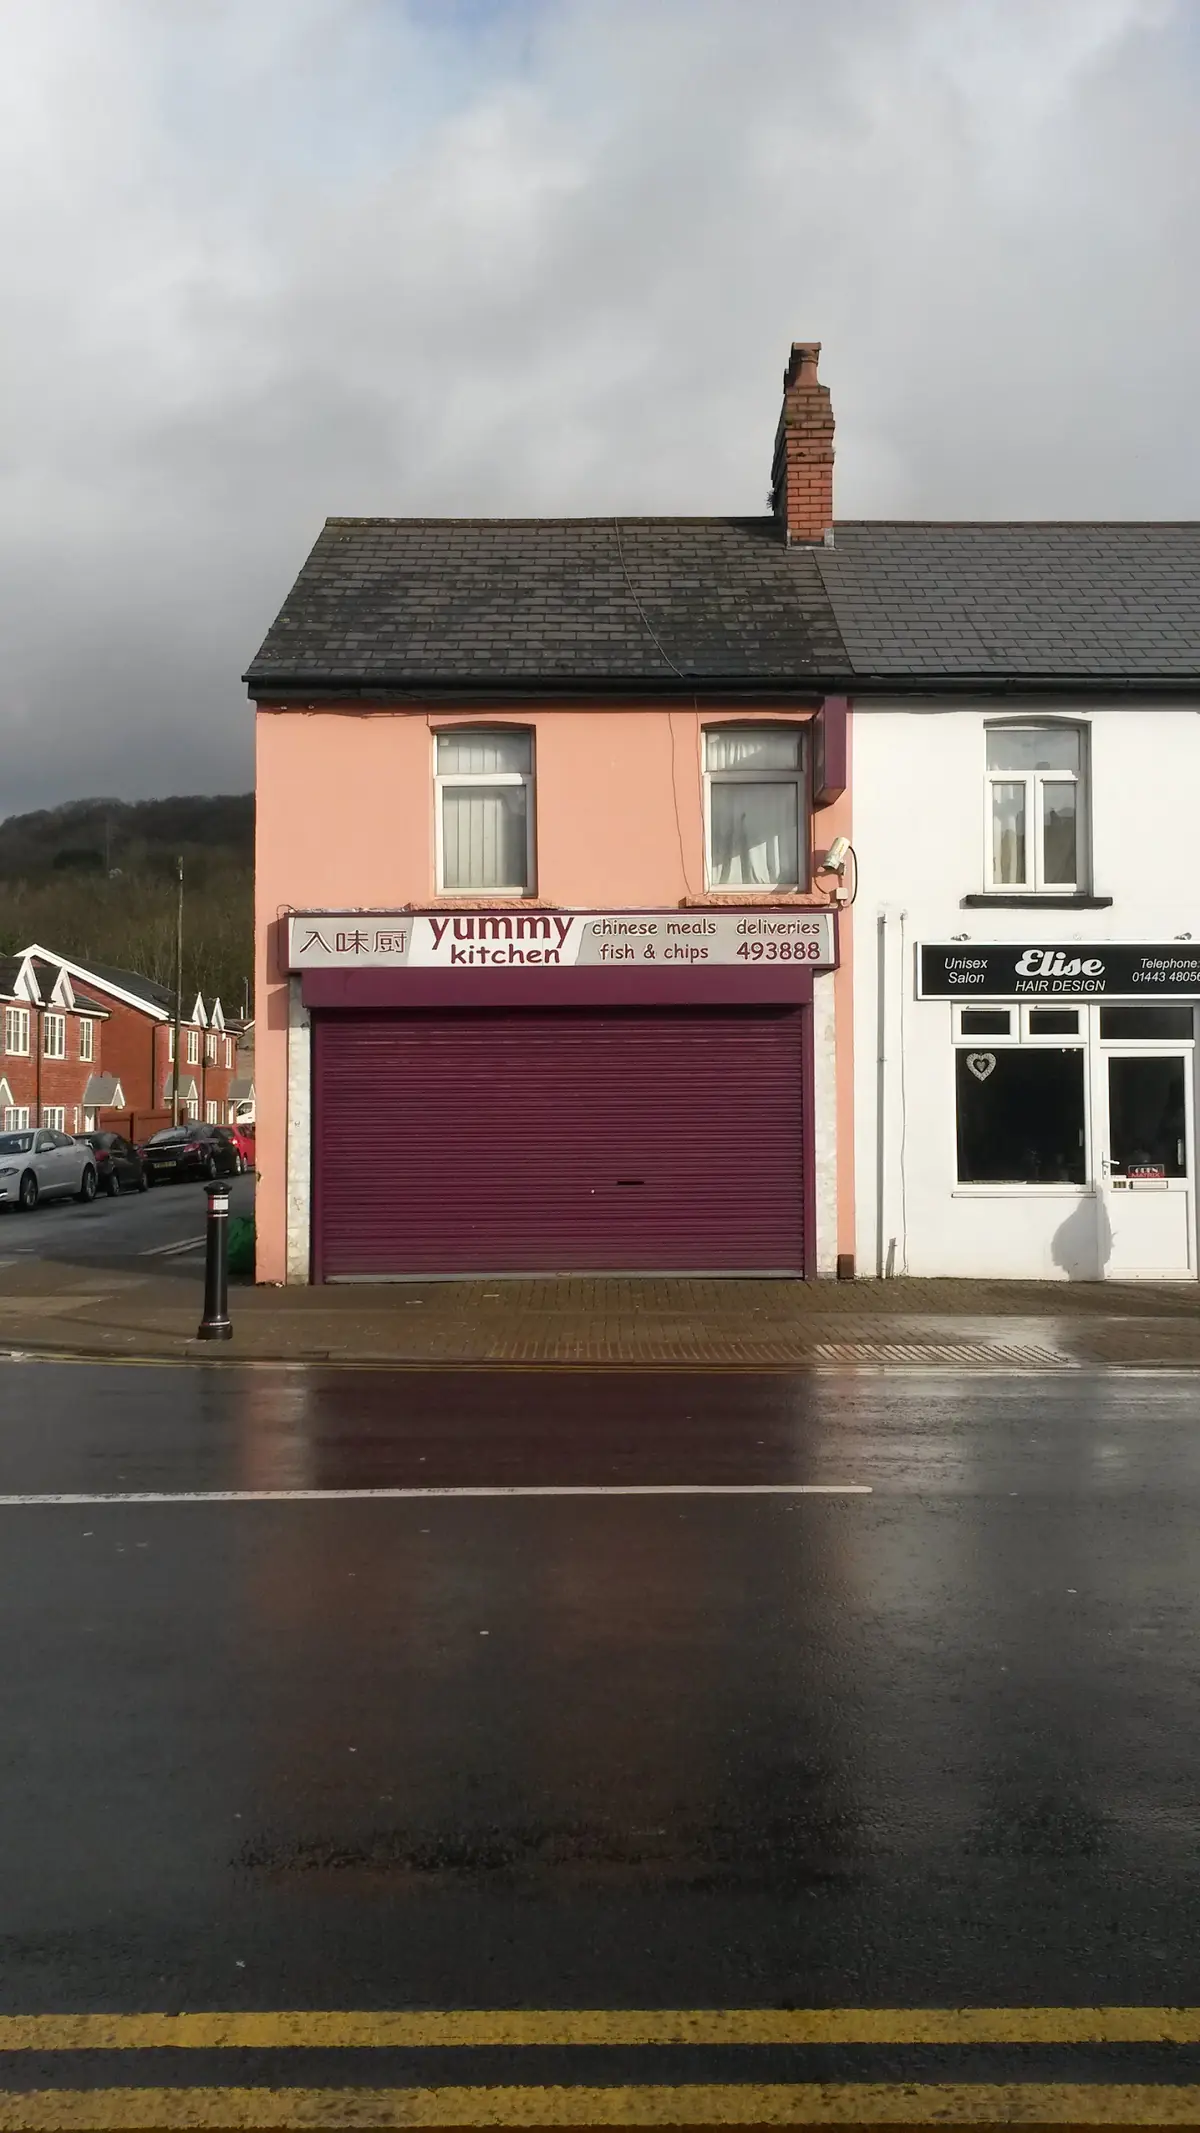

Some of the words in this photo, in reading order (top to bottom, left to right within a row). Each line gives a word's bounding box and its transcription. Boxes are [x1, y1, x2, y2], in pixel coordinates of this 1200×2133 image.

[428, 916, 575, 950] yummy
[591, 918, 658, 935] chinese
[666, 918, 716, 935] meals
[736, 917, 820, 935] deliveries
[299, 929, 407, 955] 入味厨
[736, 941, 821, 960] 493888
[450, 943, 560, 964] kitchen
[600, 943, 635, 960] fish
[643, 944, 656, 959] &
[663, 943, 709, 963] chips
[944, 957, 988, 969] Unisex
[1014, 949, 1106, 977] Elise
[948, 972, 985, 984] Salon
[1132, 971, 1166, 982] 01443
[1015, 980, 1049, 992] HAIR
[1052, 980, 1106, 991] DESIGN
